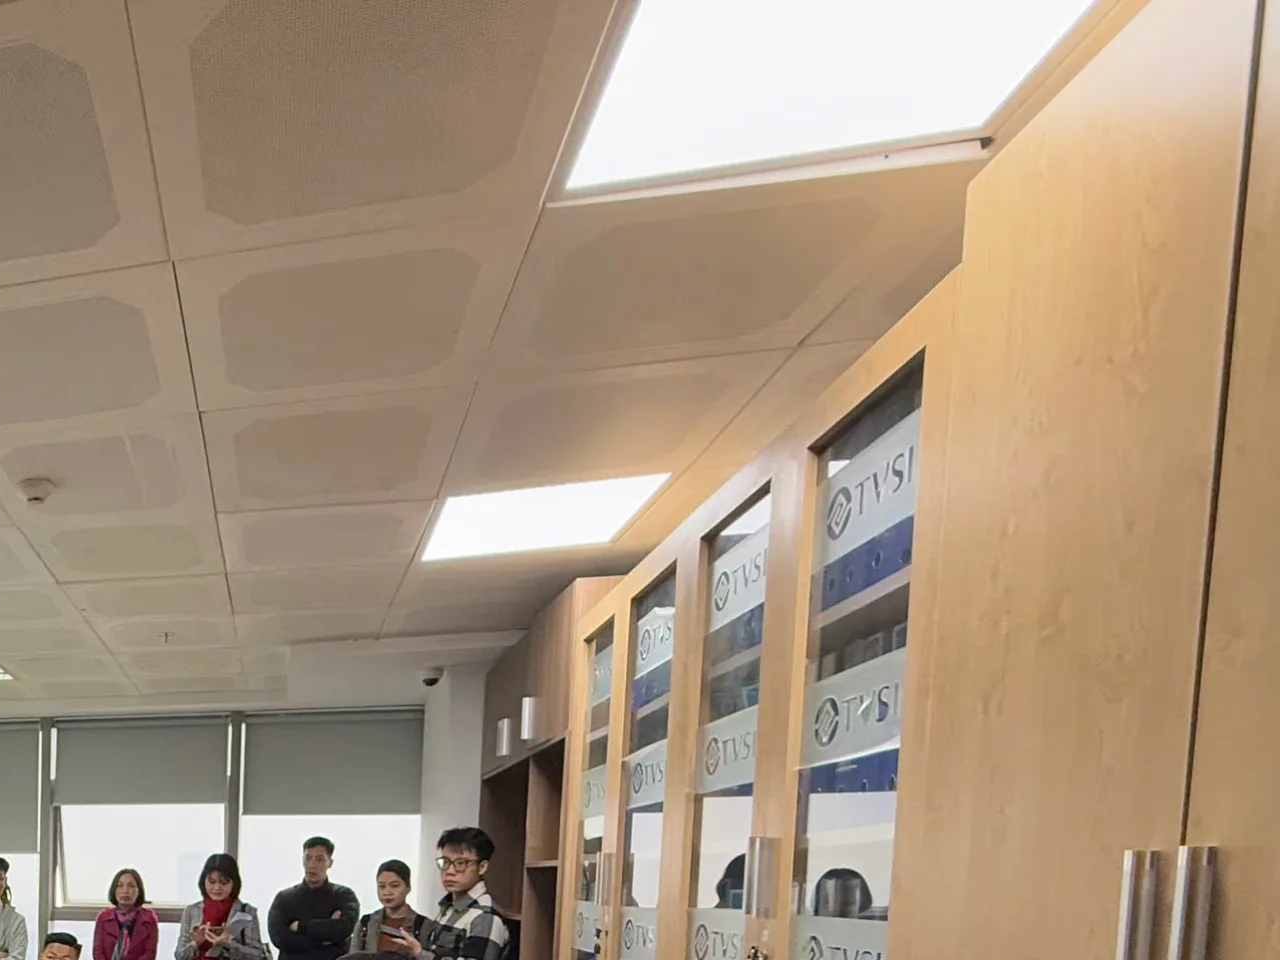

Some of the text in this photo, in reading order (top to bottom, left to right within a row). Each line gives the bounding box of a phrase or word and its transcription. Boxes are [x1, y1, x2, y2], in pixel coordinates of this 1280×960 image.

[854, 445, 914, 516] TVSI
[731, 548, 768, 595] TVSI
[652, 620, 672, 649] TVS
[841, 682, 899, 732] TVSI
[644, 760, 663, 785] TVS
[635, 925, 656, 947] TVS
